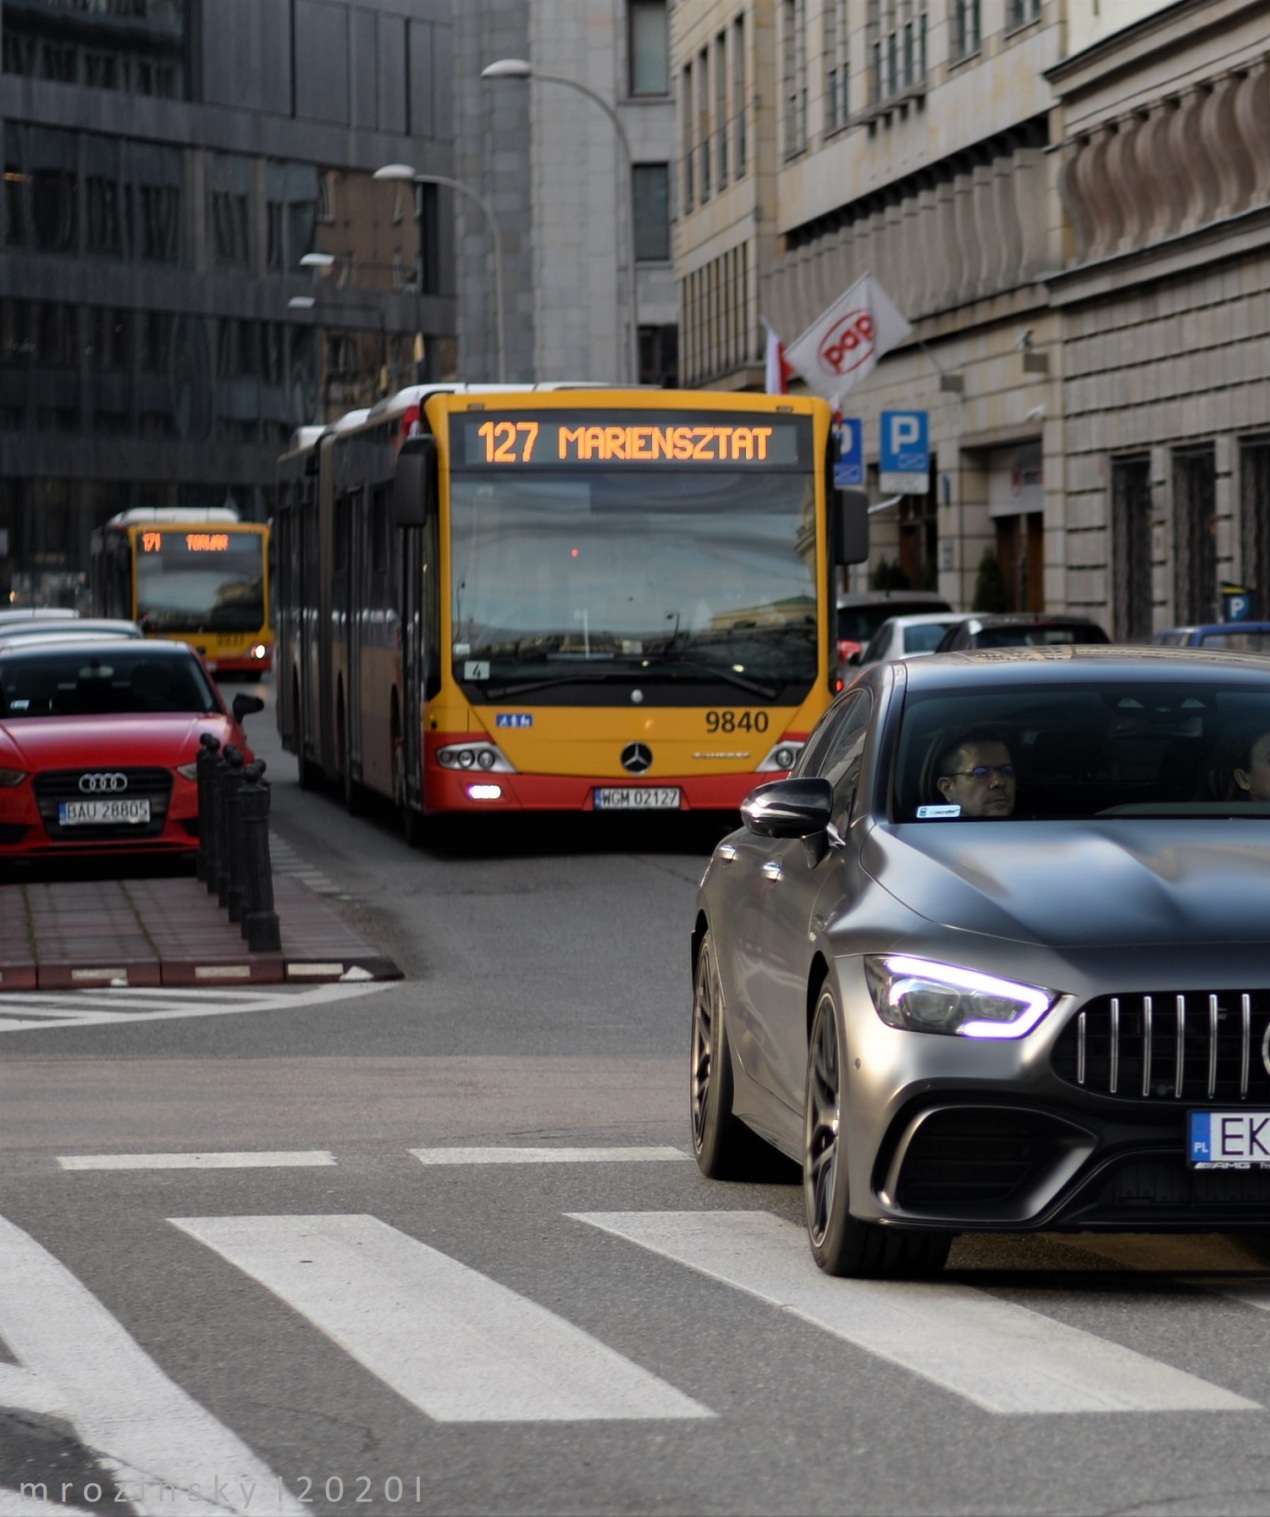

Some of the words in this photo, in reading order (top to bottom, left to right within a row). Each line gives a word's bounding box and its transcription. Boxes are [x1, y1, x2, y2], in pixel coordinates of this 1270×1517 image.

[822, 315, 873, 373] pap
[478, 421, 539, 462] 127
[558, 427, 772, 460] MARIENSZTAT
[891, 415, 920, 454] P
[1231, 597, 1245, 618] P
[704, 711, 769, 733] 9840
[602, 790, 630, 806] WGM
[634, 790, 678, 805] 02127
[68, 802, 97, 819] BAU
[102, 800, 148, 818] 28805
[1193, 1142, 1208, 1153] PL
[1212, 1161, 1251, 1169] AMG
